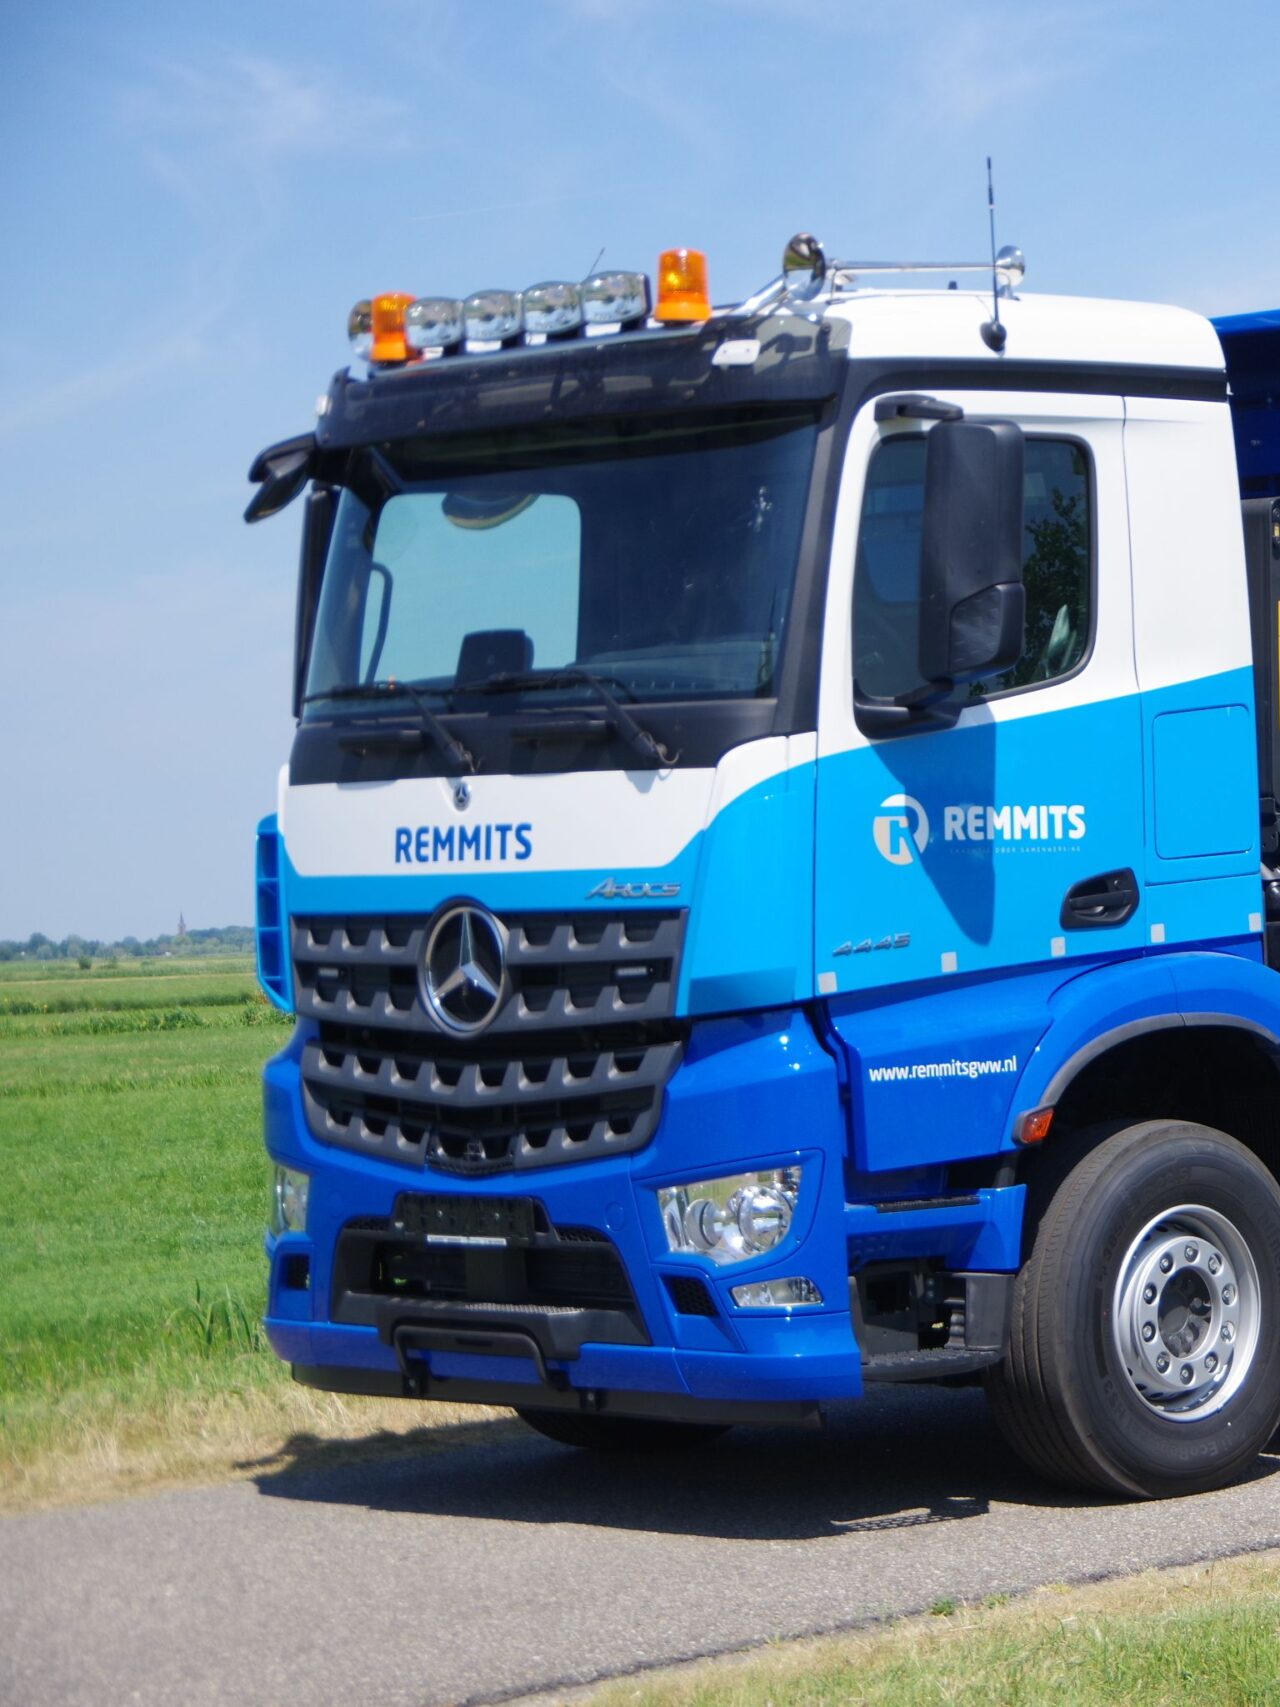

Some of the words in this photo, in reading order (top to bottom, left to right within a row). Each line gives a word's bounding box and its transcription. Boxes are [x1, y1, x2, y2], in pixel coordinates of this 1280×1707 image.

[944, 804, 1086, 841] REMMITS
[395, 822, 533, 863] REMMITS
[832, 932, 911, 957] 4445
[868, 1055, 1018, 1082] www.remmitsgww.nl
